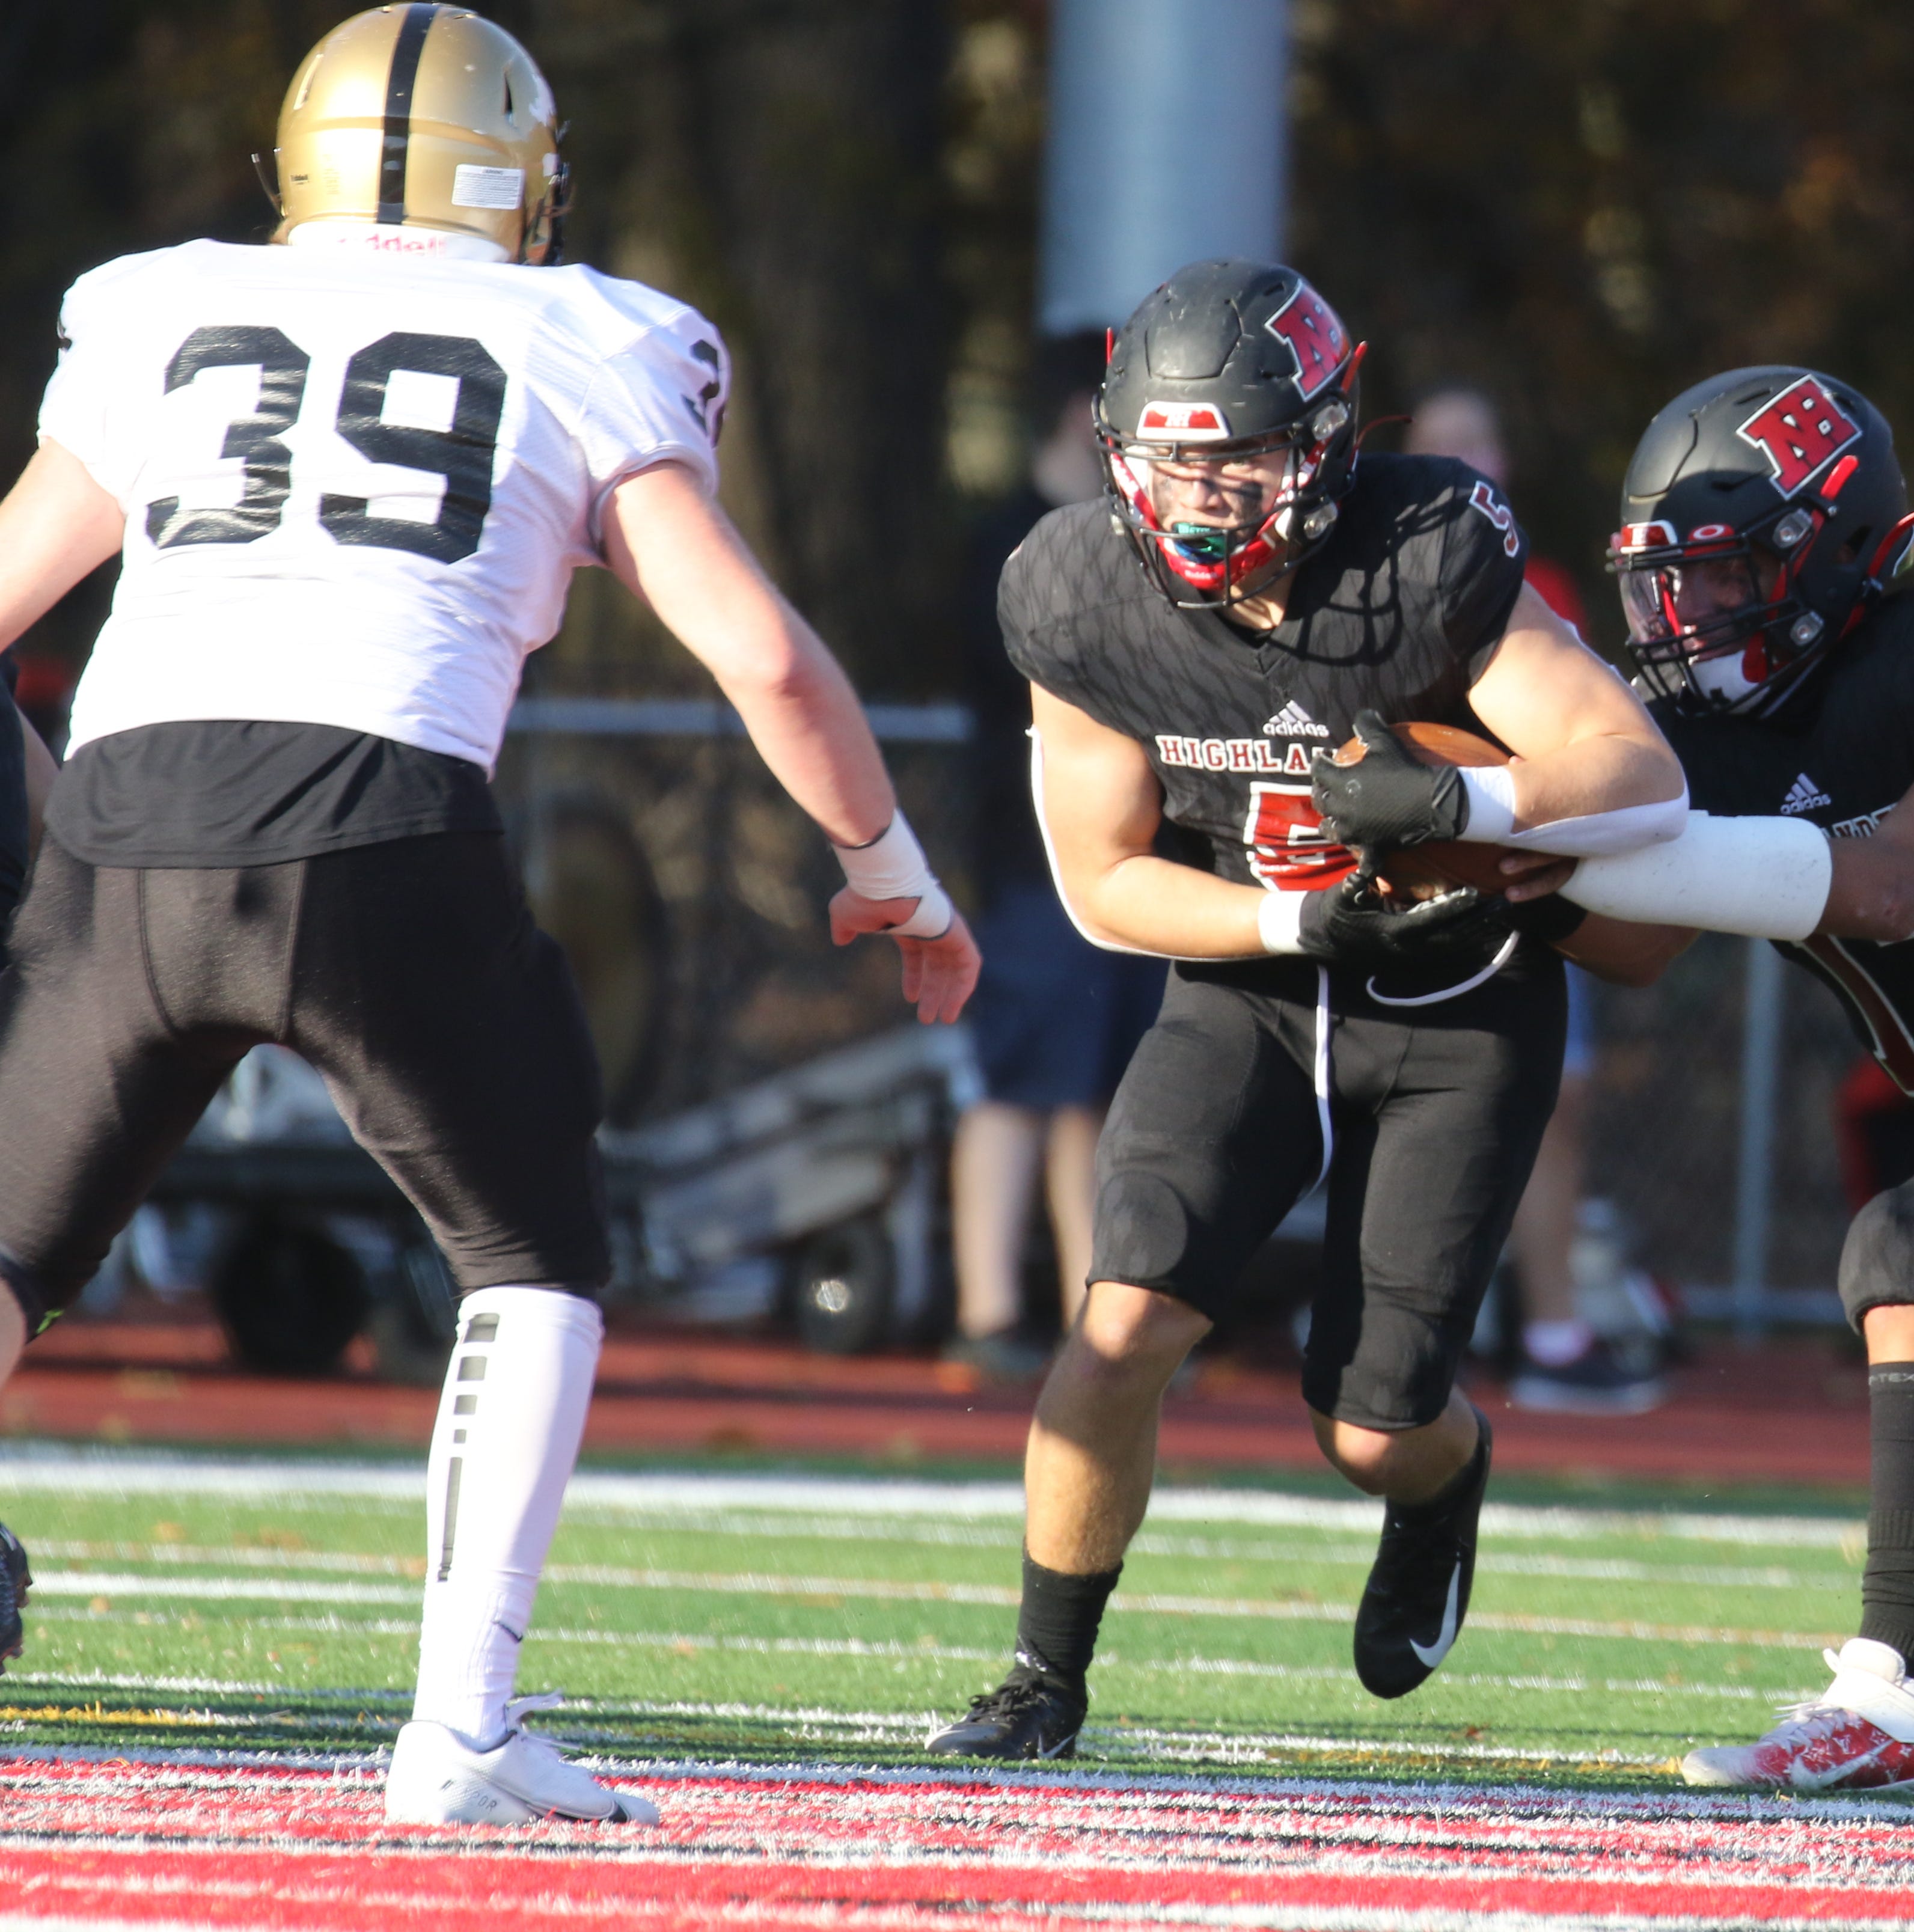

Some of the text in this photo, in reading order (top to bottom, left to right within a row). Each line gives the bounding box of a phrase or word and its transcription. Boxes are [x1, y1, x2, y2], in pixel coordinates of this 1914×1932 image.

[145, 325, 507, 564] 39
[1469, 480, 1520, 558] 5
[1155, 735, 1340, 775] HIGHLA
[1262, 721, 1330, 738] adidas
[1780, 793, 1832, 815] adidas
[1243, 781, 1362, 892] 5
